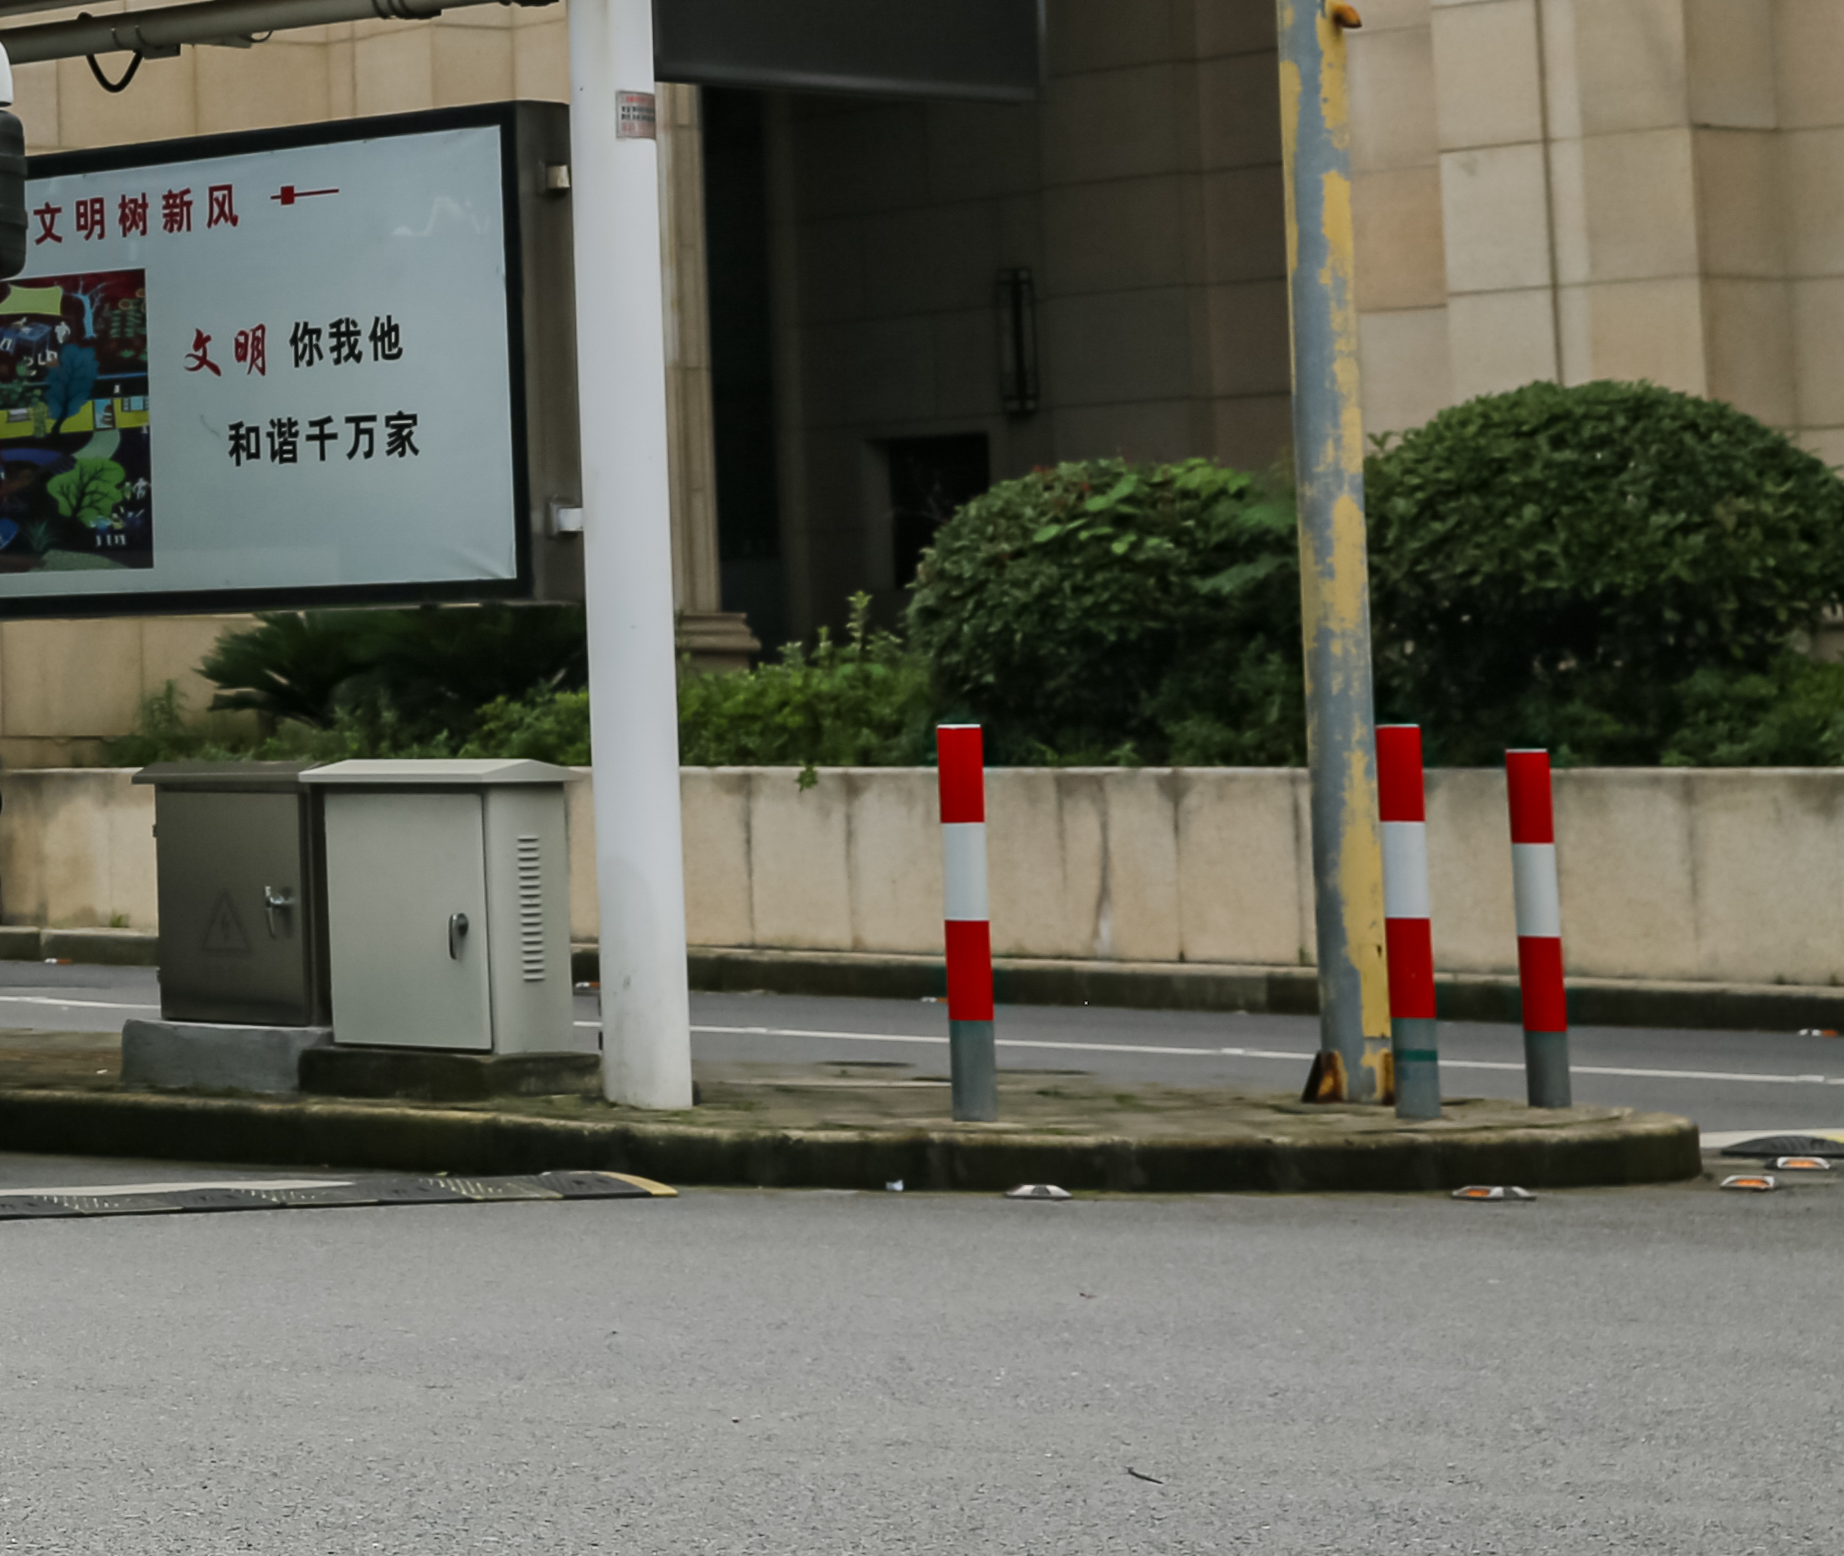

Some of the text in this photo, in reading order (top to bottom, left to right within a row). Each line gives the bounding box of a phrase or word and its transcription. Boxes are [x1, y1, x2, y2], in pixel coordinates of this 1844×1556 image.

[33, 184, 239, 245] 文明树新风
[184, 315, 403, 377] 文明 你我他
[228, 410, 420, 467] 和谐千万家
